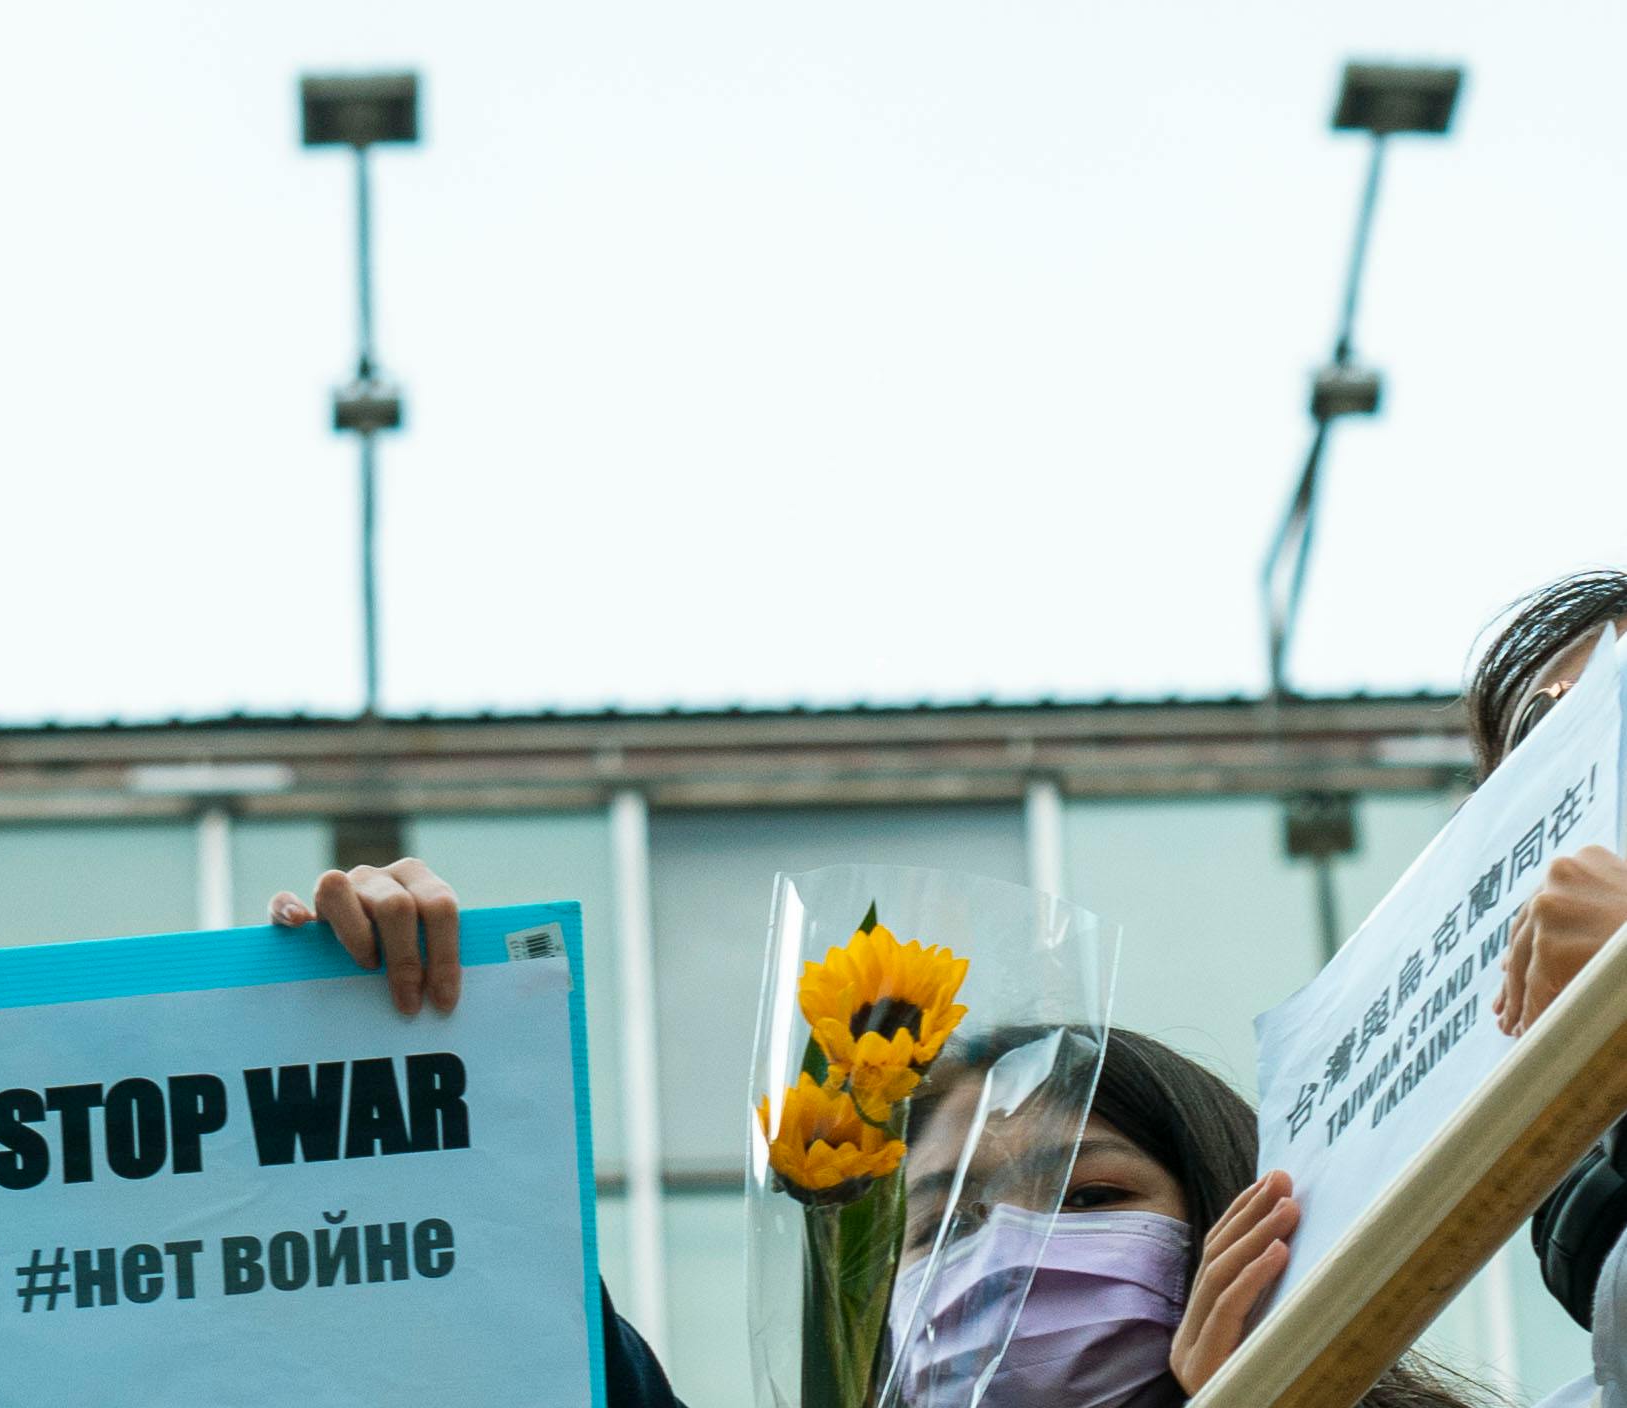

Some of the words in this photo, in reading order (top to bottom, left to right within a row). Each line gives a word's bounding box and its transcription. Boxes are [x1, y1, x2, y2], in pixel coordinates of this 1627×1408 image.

[1326, 1033, 1404, 1147] TAIWAN
[1406, 953, 1475, 1050] STAND
[1481, 901, 1525, 971] WI
[1371, 991, 1479, 1130] UKRAINE!!
[242, 1052, 471, 1167] WAR
[15, 1239, 204, 1314] #нет
[221, 1209, 456, 1296] войне
